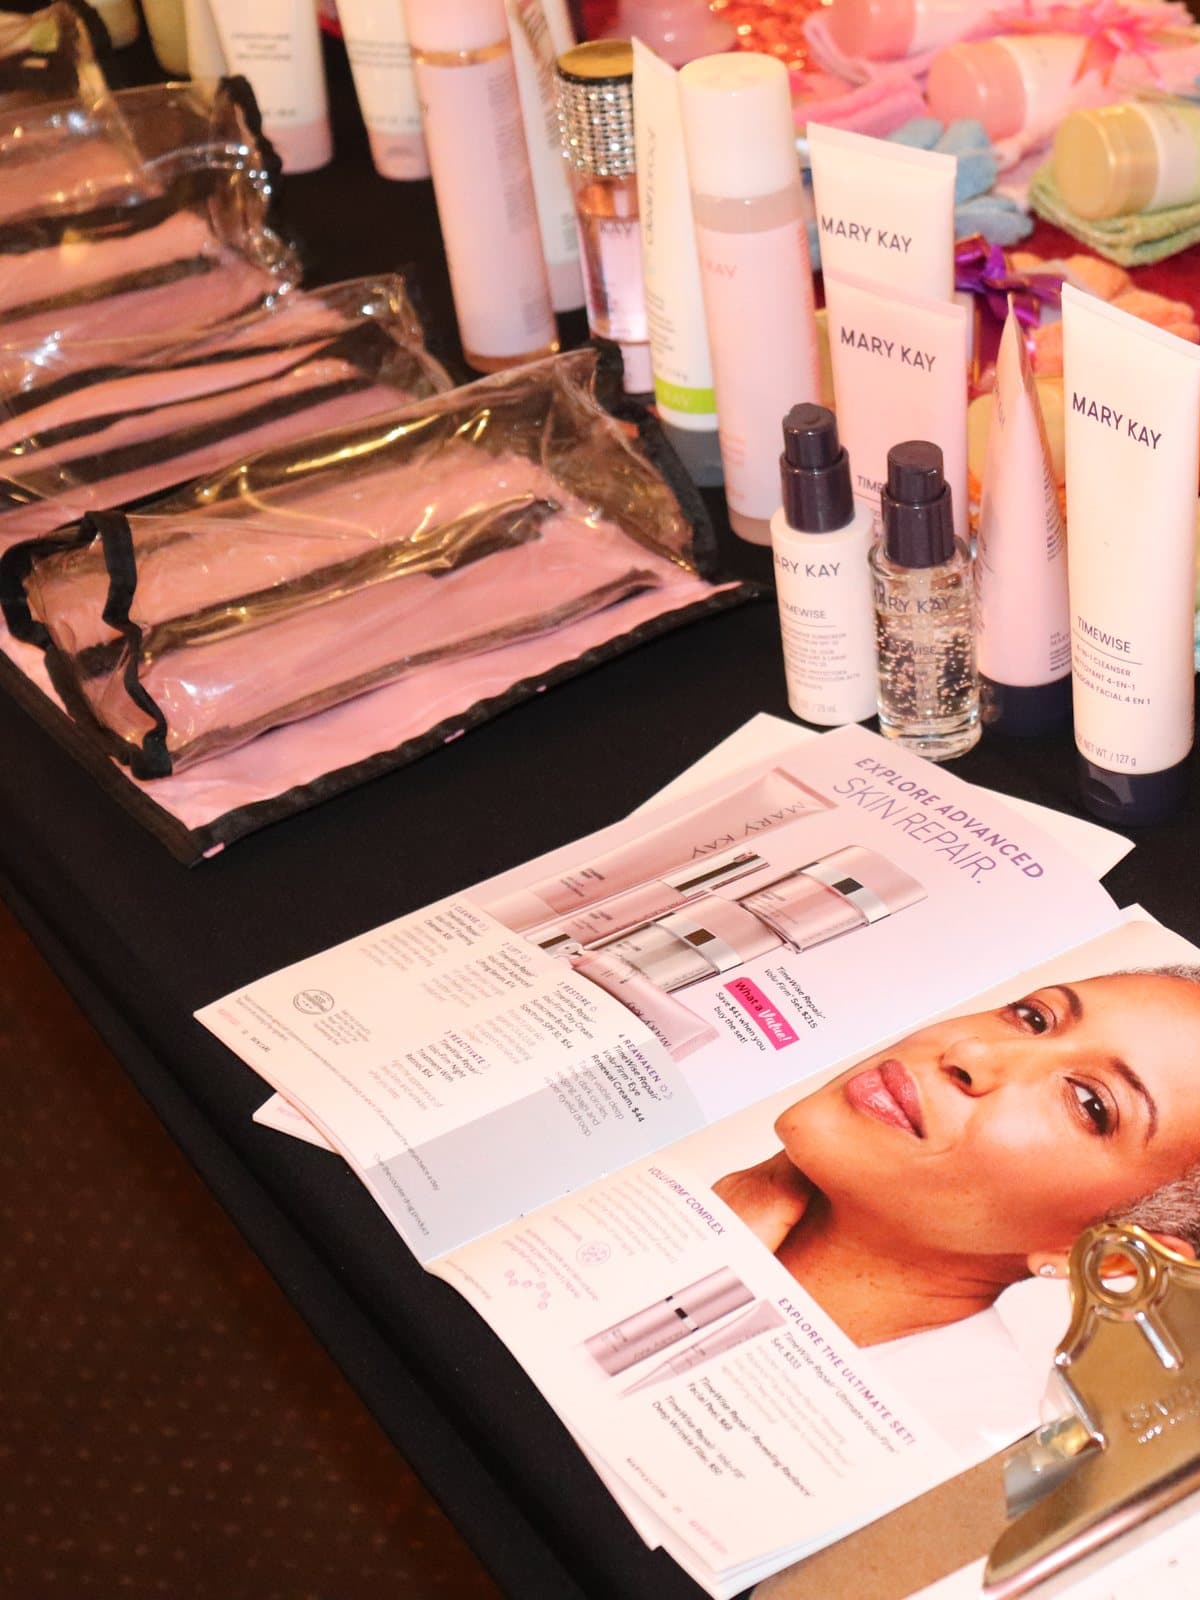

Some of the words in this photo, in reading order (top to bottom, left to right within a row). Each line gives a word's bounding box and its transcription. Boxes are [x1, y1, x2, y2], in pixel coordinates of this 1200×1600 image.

[821, 216, 871, 245] MARY
[878, 233, 912, 254] KAY
[841, 326, 894, 357] MARY
[901, 345, 936, 373] KAY
[1072, 392, 1123, 431] MARY
[1128, 419, 1162, 450] KAY
[856, 475, 884, 494] TIME
[775, 554, 799, 574] ARY
[806, 562, 841, 578] KAY
[1077, 616, 1132, 653] TIMEWISE
[1094, 658, 1132, 677] CLEANSER
[1106, 677, 1136, 691] 4-EN-1
[1096, 686, 1122, 702] FACIAL
[1133, 697, 1145, 705] EN
[1116, 753, 1129, 765] 127
[744, 801, 805, 836] MARY
[833, 773, 907, 826] SKIN
[893, 808, 997, 884] REPAIR.
[855, 756, 934, 804] EXPLORE
[934, 800, 1046, 881] ADVANCED
[691, 834, 736, 859] KAY
[563, 985, 592, 1006] RESTORE
[777, 964, 806, 996] TimeWise
[556, 1019, 571, 1034] Broad
[713, 1004, 728, 1020] buy
[724, 1016, 737, 1031] the
[733, 1028, 748, 1044] set!
[715, 989, 732, 1008] Save
[728, 1003, 742, 1018] $41
[737, 1016, 756, 1037] when
[750, 1034, 767, 1051] you
[735, 979, 759, 1006] What
[758, 1006, 793, 1045] Value!
[800, 1009, 818, 1029] $215
[575, 1023, 594, 1039] Cream
[450, 1034, 485, 1064] REACTIVATE
[613, 1043, 641, 1077] TimeWise
[623, 1038, 660, 1083] REAWAKEN
[591, 1052, 616, 1083] Renewal
[612, 1079, 635, 1108] Cream,
[630, 1105, 646, 1123] $44
[626, 1080, 642, 1098] Eye
[685, 1197, 726, 1236] COMPLEX
[783, 1332, 814, 1367] TimeWise
[778, 1298, 823, 1346] EXPLORE
[822, 1344, 840, 1368] THE
[841, 1369, 892, 1420] ULTIMATE
[890, 1417, 916, 1445] SET!
[688, 1382, 706, 1404] Facial
[700, 1376, 730, 1410] TimeWise
[652, 1401, 670, 1421] Deep
[666, 1395, 696, 1428] TimeWise
